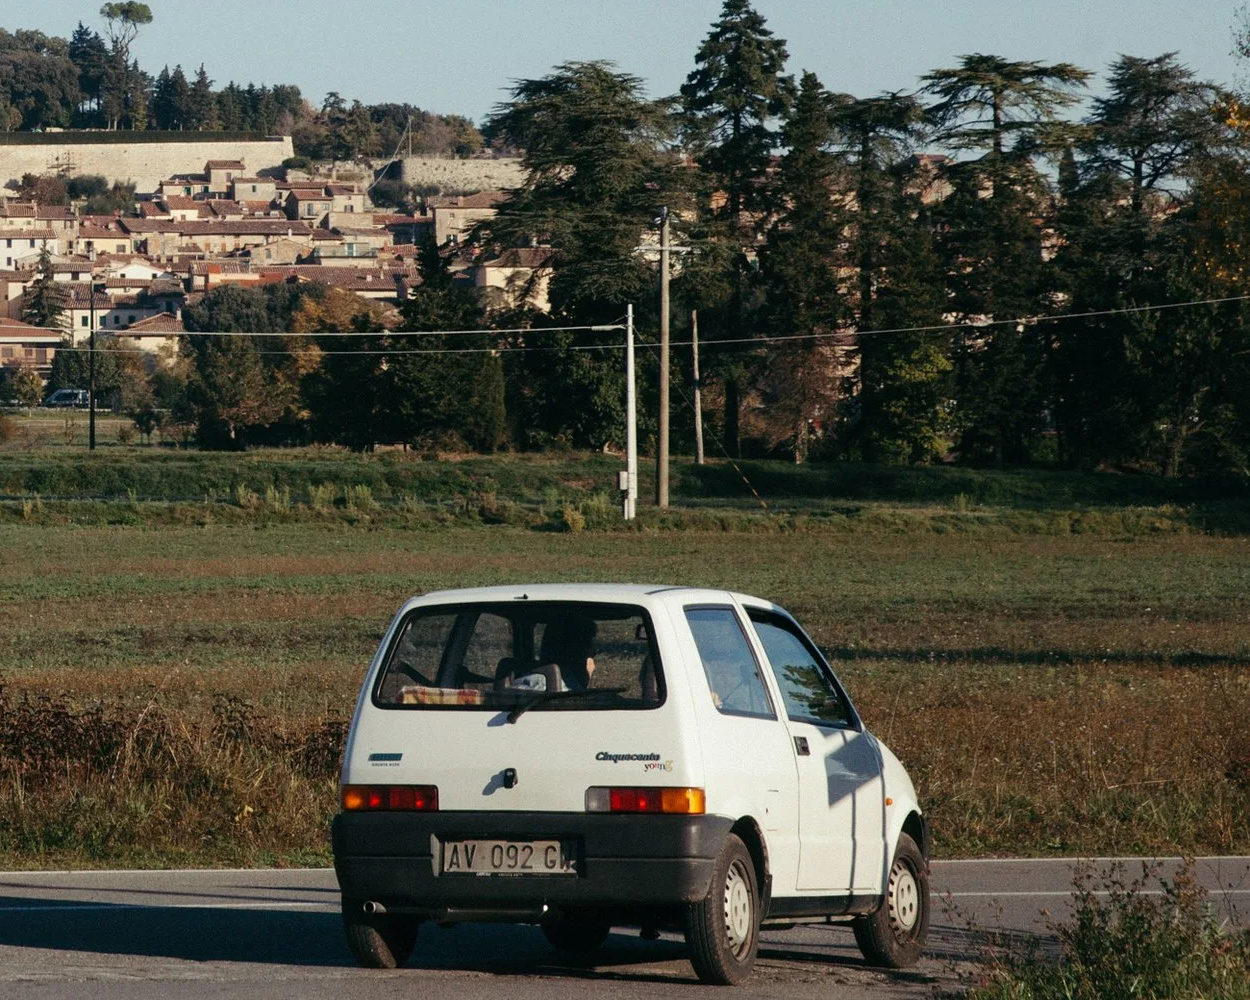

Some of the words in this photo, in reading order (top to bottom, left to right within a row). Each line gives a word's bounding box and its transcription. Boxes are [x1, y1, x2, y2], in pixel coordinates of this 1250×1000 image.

[644, 760, 673, 772] young
[449, 844, 476, 869] AV
[491, 845, 534, 869] 092
